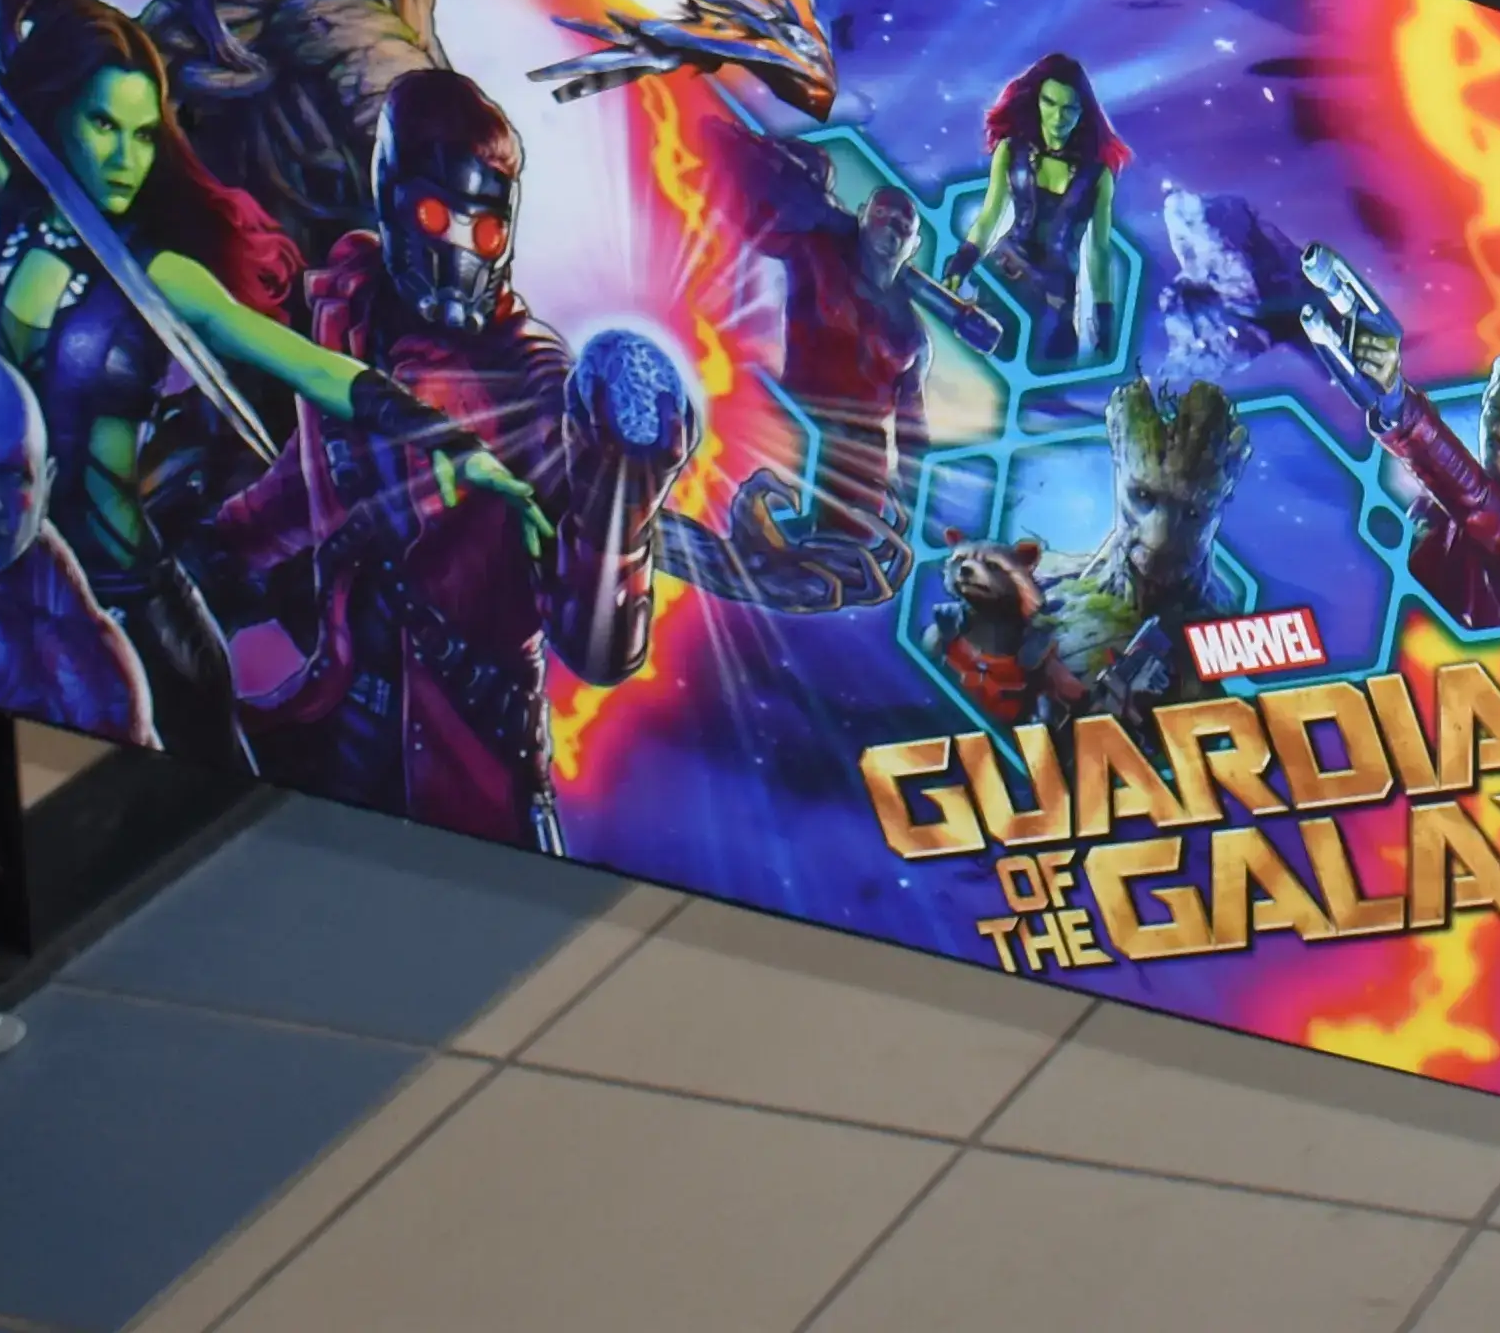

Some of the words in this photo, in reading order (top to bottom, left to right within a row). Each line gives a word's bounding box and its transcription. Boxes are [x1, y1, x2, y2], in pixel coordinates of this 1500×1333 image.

[1187, 610, 1322, 676] MARVEL
[994, 849, 1078, 913] OF
[978, 908, 1114, 974] THE
